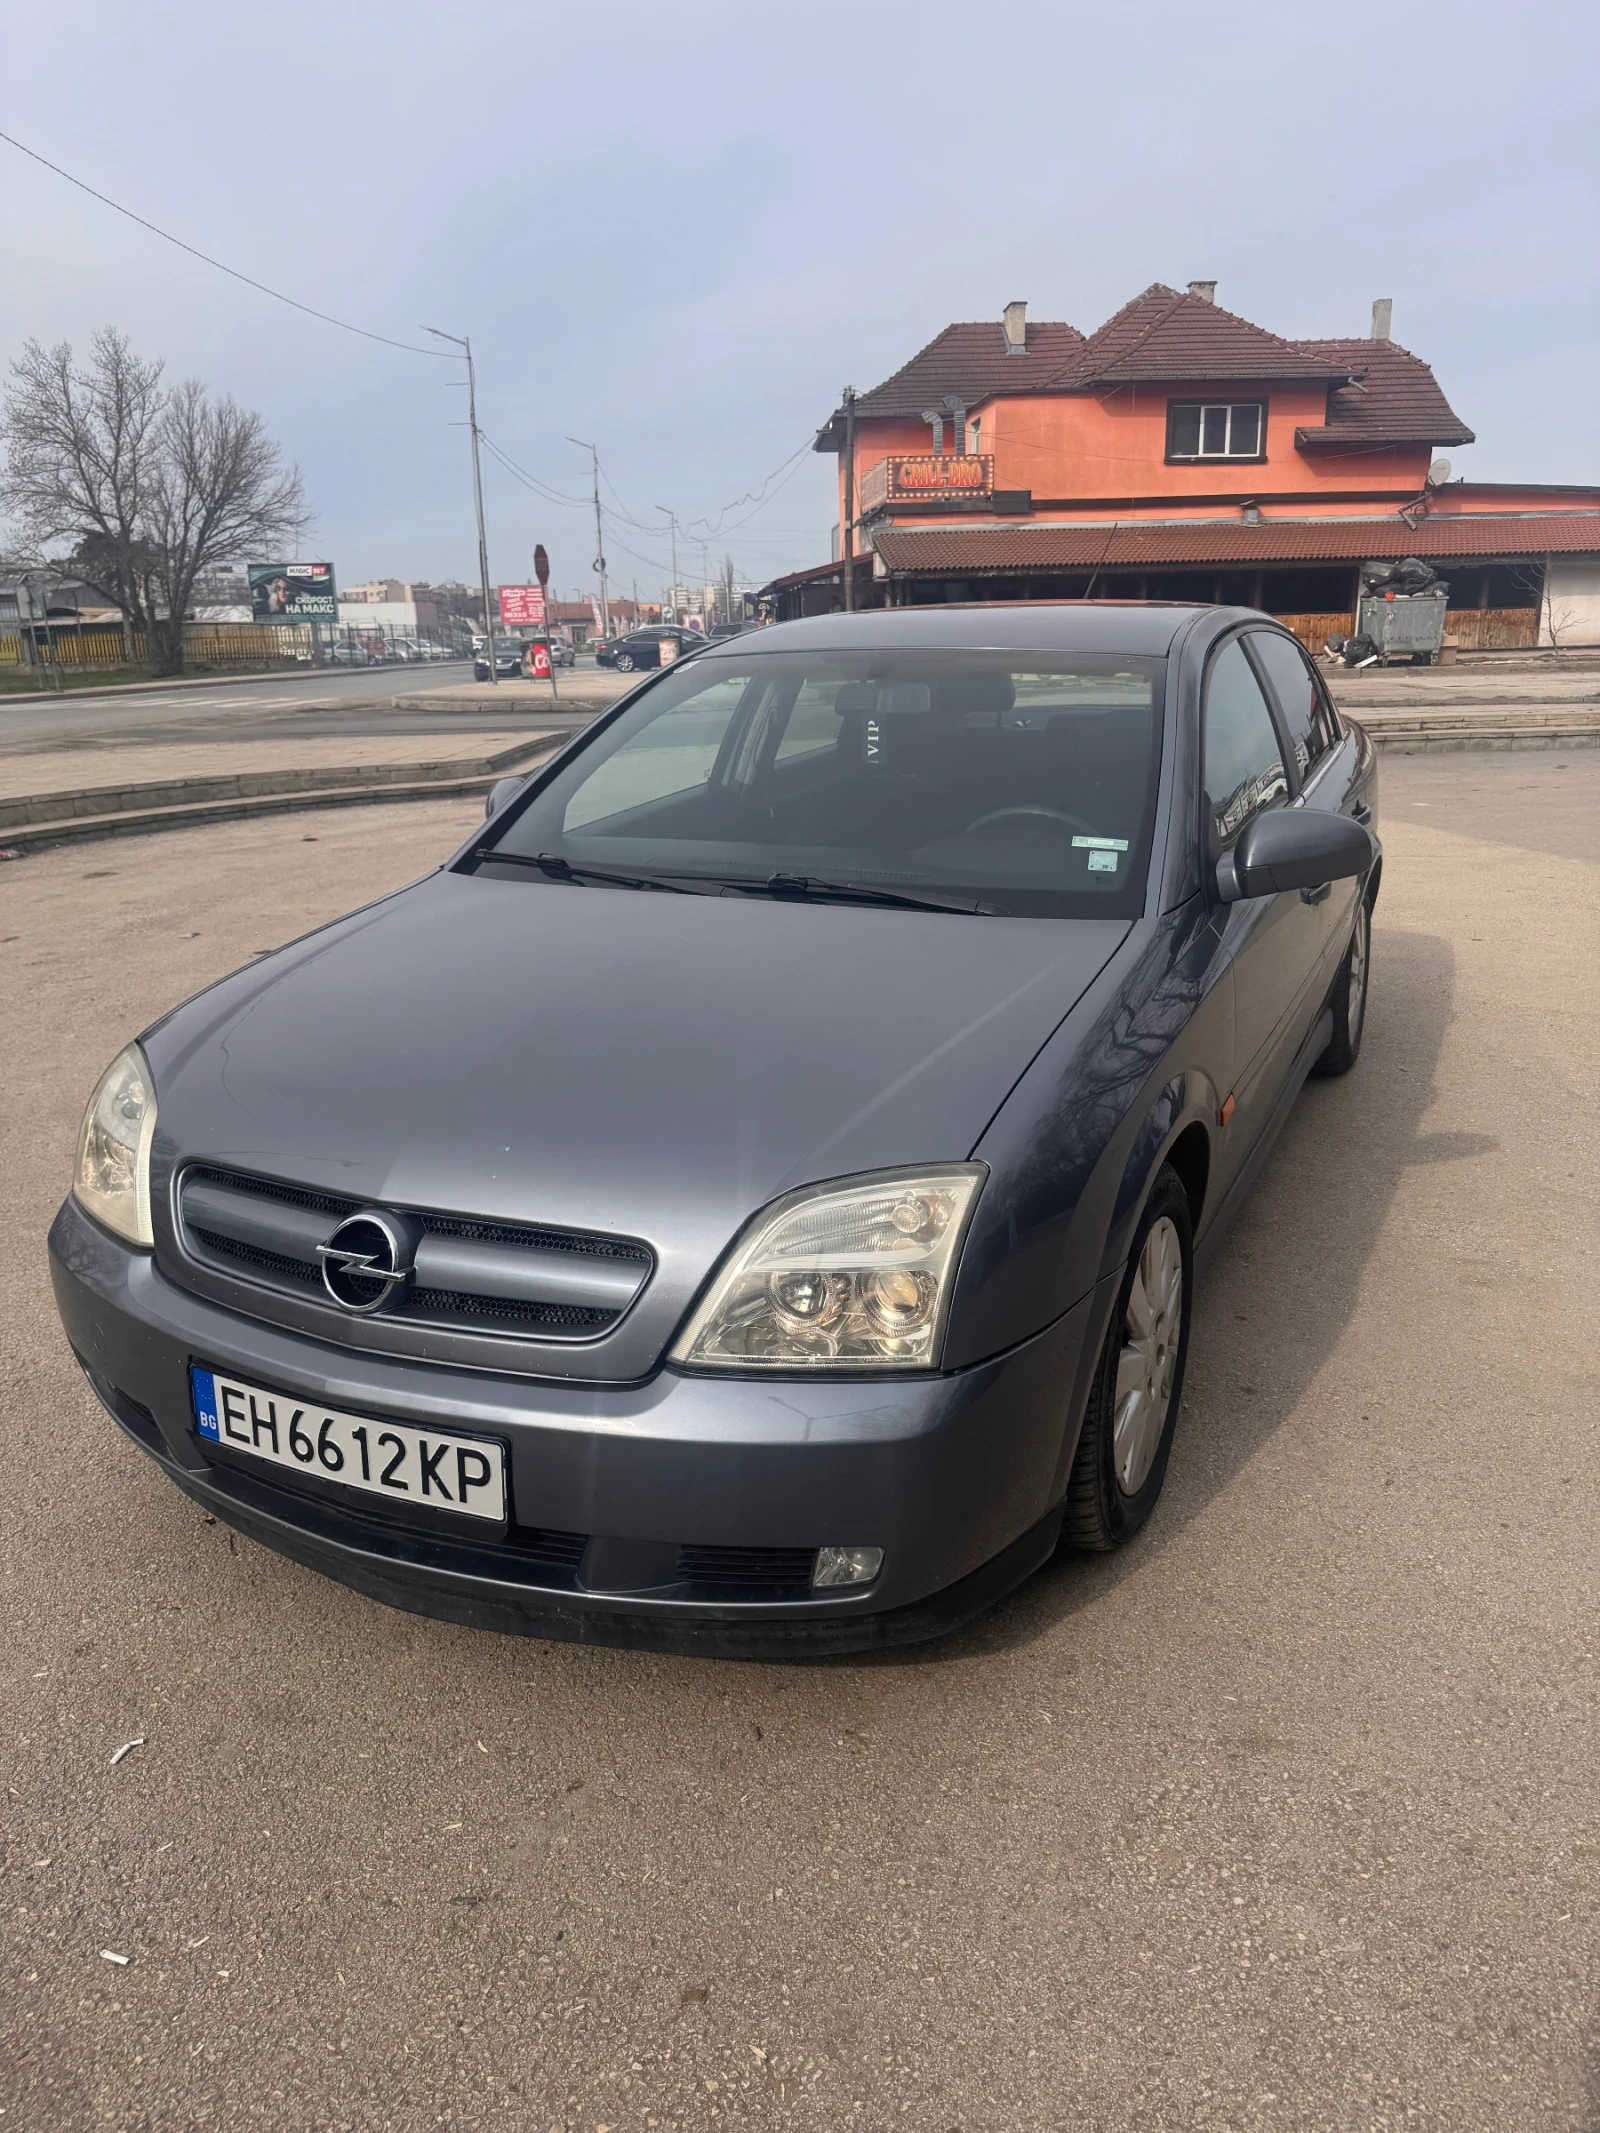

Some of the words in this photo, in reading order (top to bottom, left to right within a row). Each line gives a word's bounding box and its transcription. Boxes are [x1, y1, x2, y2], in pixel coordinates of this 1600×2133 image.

[899, 463, 946, 488] GRILL
[948, 462, 983, 488] BRO
[285, 605, 301, 613] НА
[303, 604, 334, 613] МАКС
[867, 720, 879, 756] VIP
[200, 1410, 217, 1430] BG
